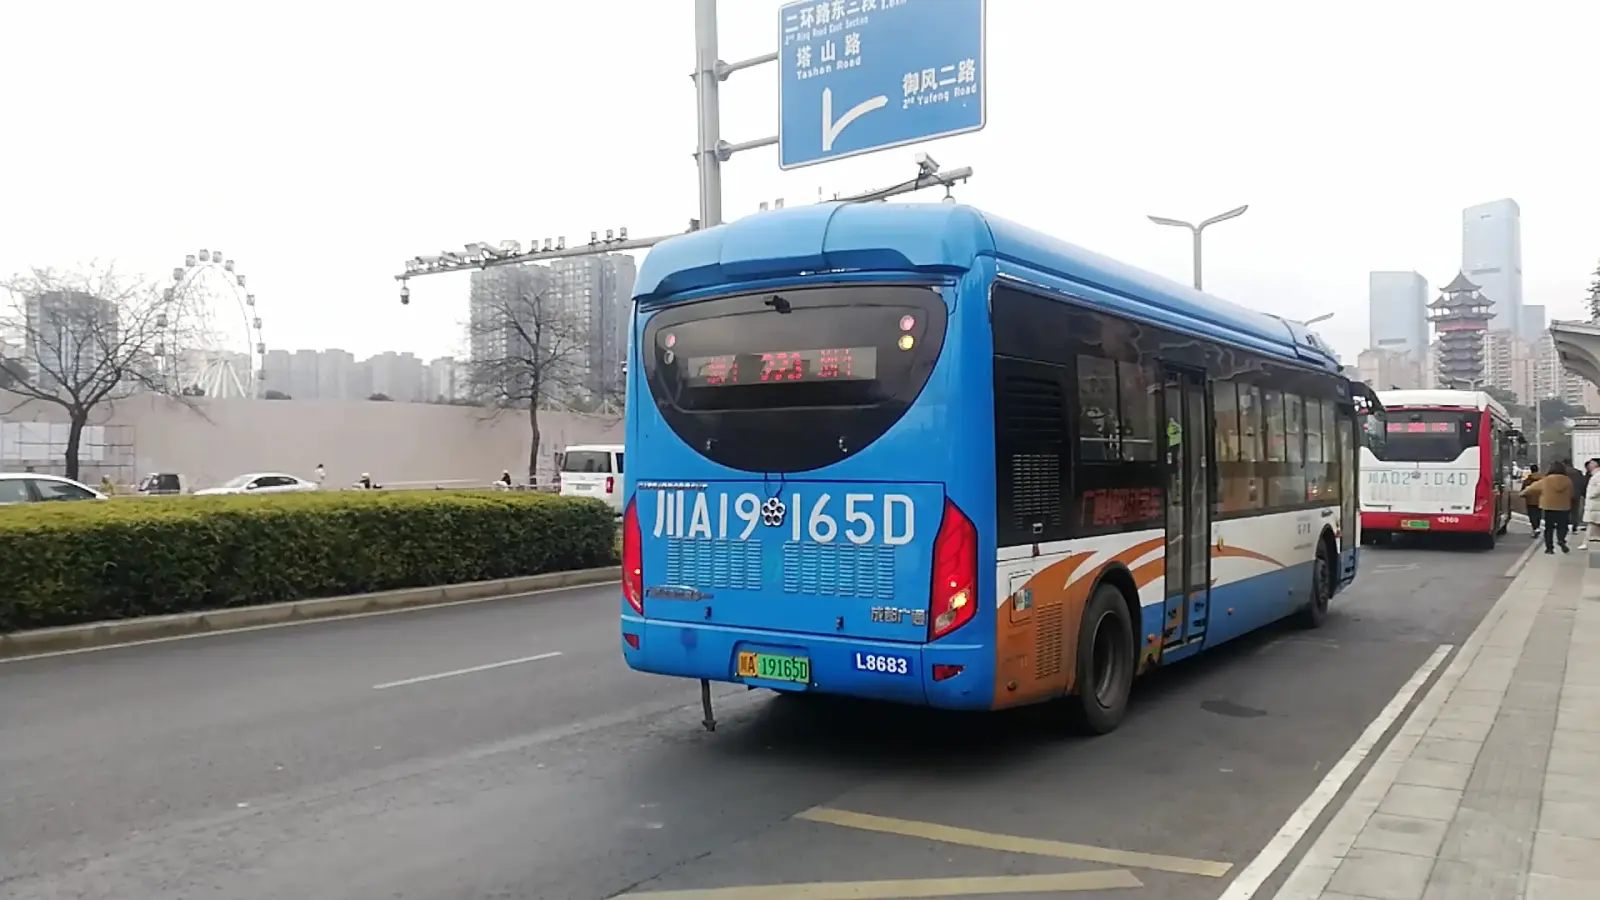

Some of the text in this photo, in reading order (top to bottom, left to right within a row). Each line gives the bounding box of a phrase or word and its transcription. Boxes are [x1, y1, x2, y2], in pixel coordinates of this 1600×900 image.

[812, 25, 828, 37] Road
[796, 32, 861, 69] 塔山路
[796, 55, 862, 80] Tashan Road
[902, 58, 976, 97] 御风二路
[916, 90, 950, 106] Yufeng
[954, 82, 977, 97] Road
[653, 490, 915, 546] 川A19 165D
[856, 652, 908, 674] L8683
